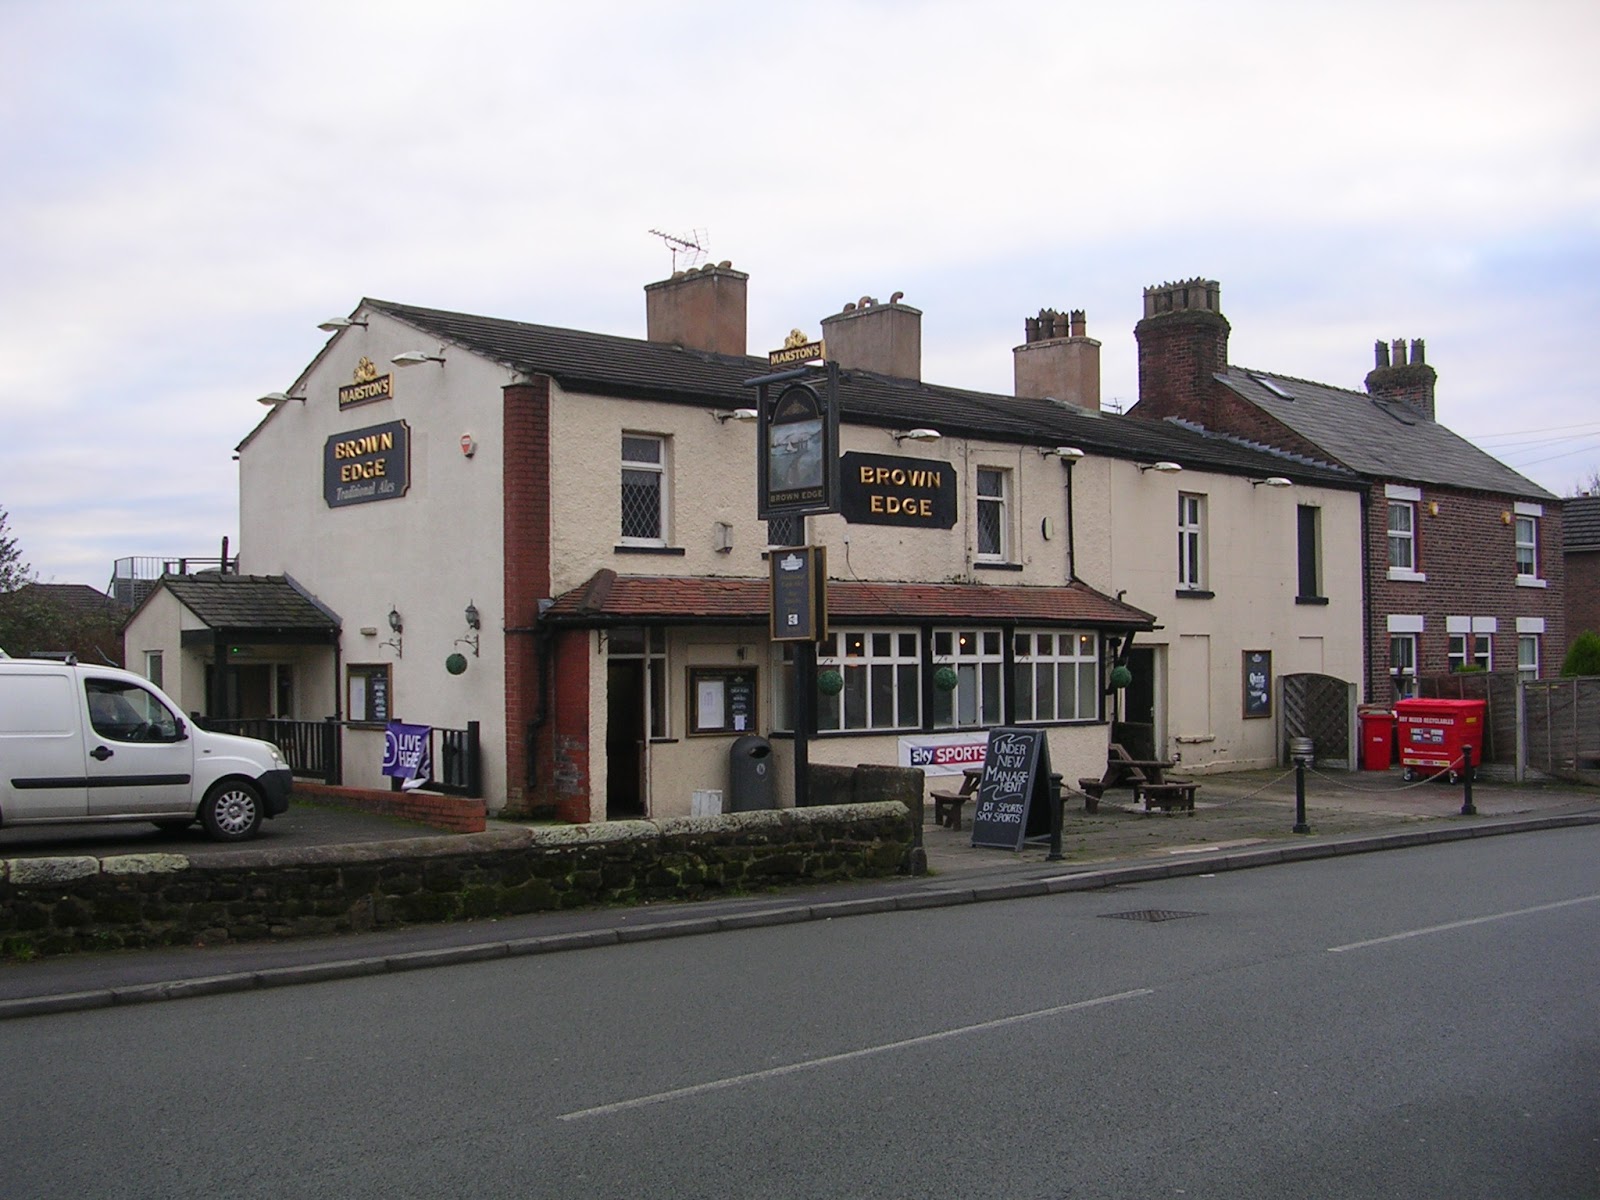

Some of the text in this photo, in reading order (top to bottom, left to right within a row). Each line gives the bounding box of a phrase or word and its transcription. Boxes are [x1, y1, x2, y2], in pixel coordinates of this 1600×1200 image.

[770, 347, 820, 365] MARSTON'S
[340, 379, 389, 404] MARSTON'S
[335, 431, 393, 459] BROWN
[341, 458, 386, 482] EDGE
[859, 466, 941, 488] BROWN
[770, 489, 823, 503] BROWN EDGE
[870, 495, 933, 516] EDGE
[399, 734, 421, 751] LIVE
[995, 743, 1026, 755] UNDER
[912, 745, 987, 765] sky SPORTS
[997, 755, 1024, 768] NEW
[999, 781, 1023, 793] MENT
[983, 802, 1024, 815] BT SPORTS
[977, 811, 1021, 824] SKY SPORTS
